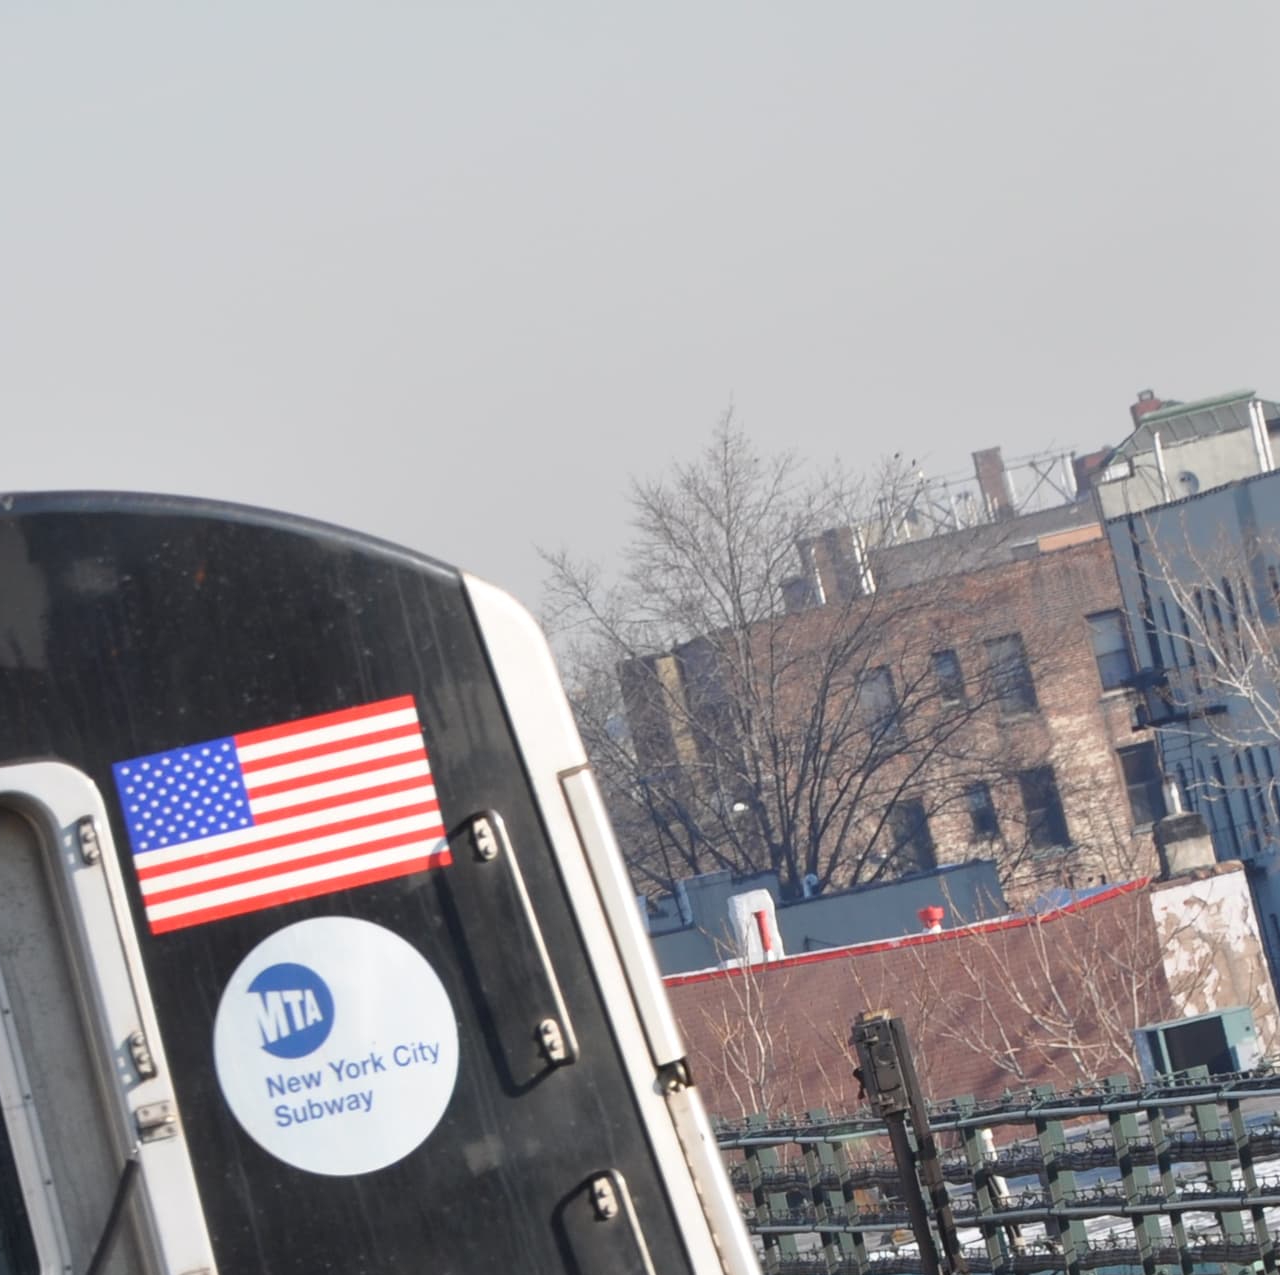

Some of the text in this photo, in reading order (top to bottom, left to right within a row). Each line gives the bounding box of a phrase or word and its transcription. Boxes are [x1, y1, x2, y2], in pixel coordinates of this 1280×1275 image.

[247, 988, 325, 1046] MTA
[265, 1042, 441, 1099] New York City
[274, 1089, 374, 1128] Subway
